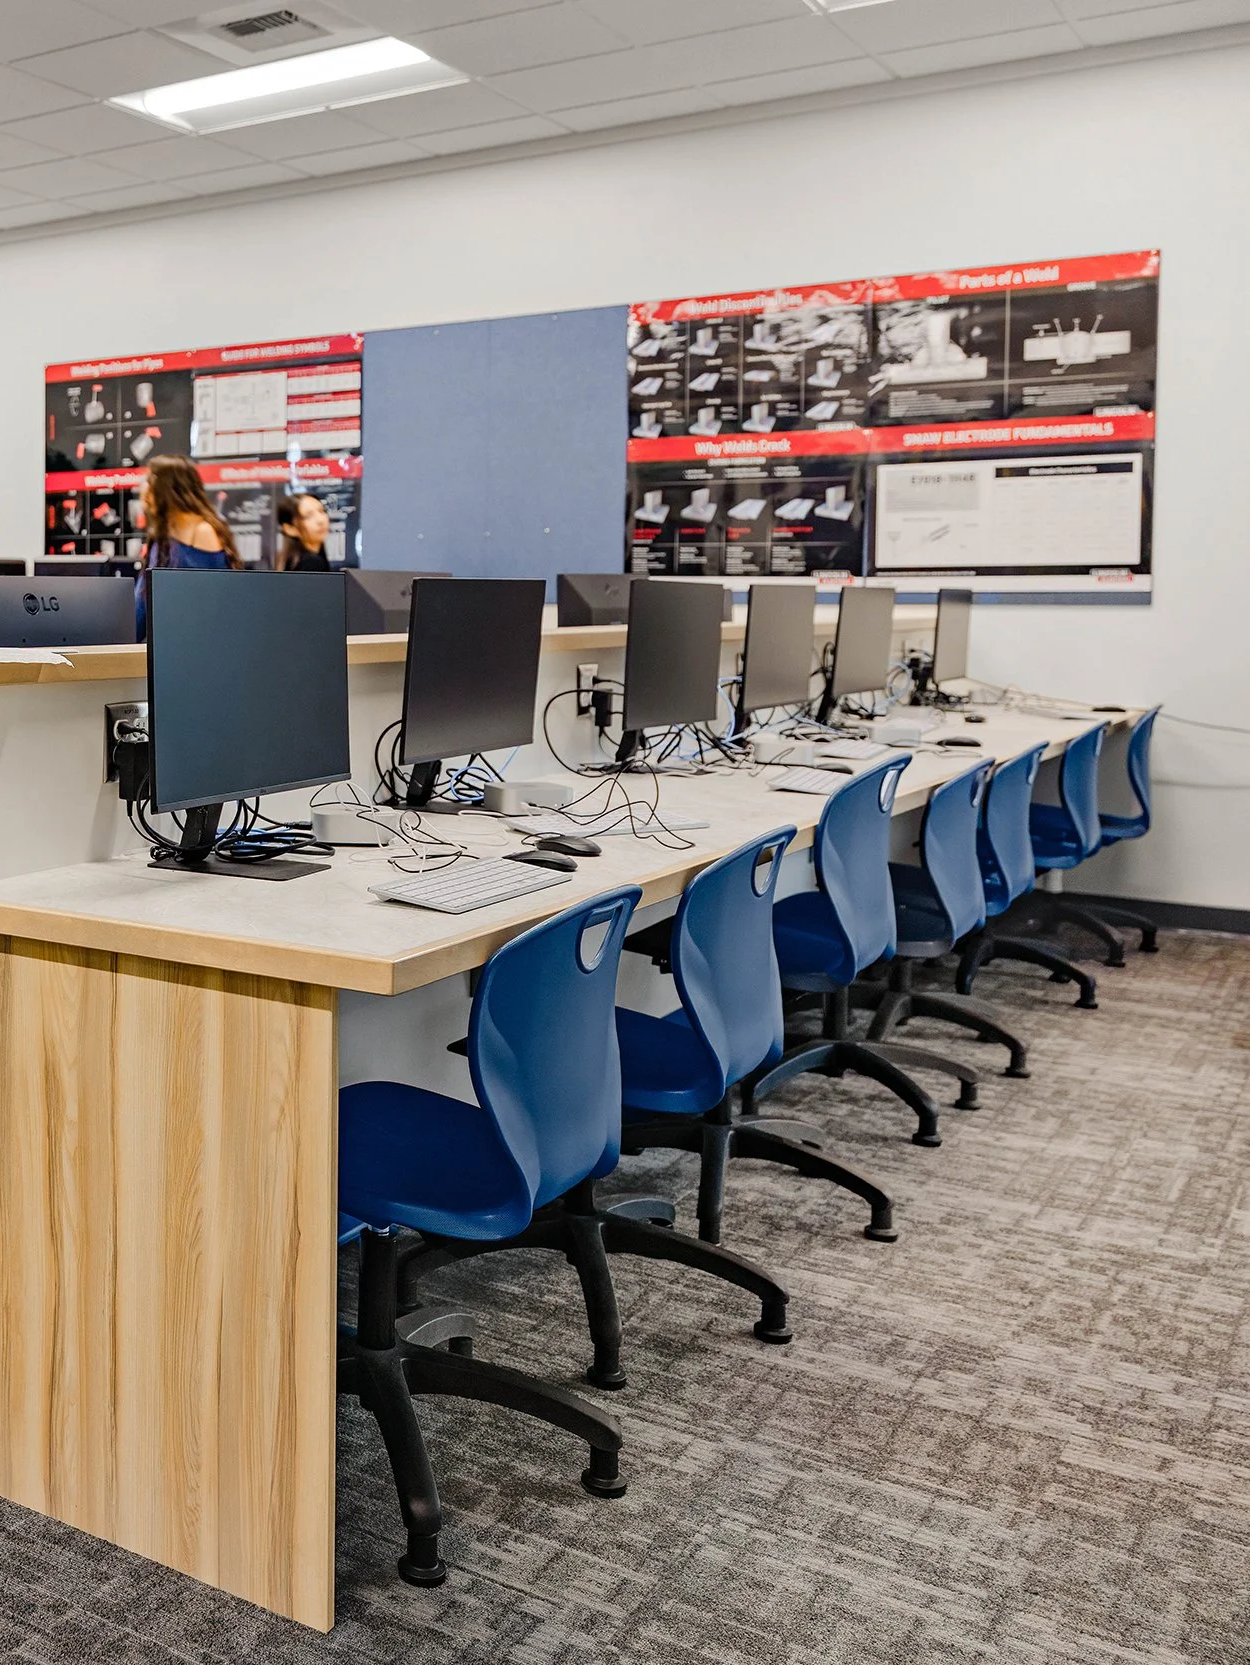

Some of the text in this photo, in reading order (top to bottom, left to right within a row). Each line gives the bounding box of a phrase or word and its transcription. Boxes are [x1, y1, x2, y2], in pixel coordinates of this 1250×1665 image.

[959, 265, 1060, 290] Parts of a Weld
[942, 427, 1011, 444] ELECTRODE
[1012, 422, 1114, 441] FUNDAMENTALS
[694, 438, 791, 457] Why Welds Crack
[41, 596, 60, 612] LG
